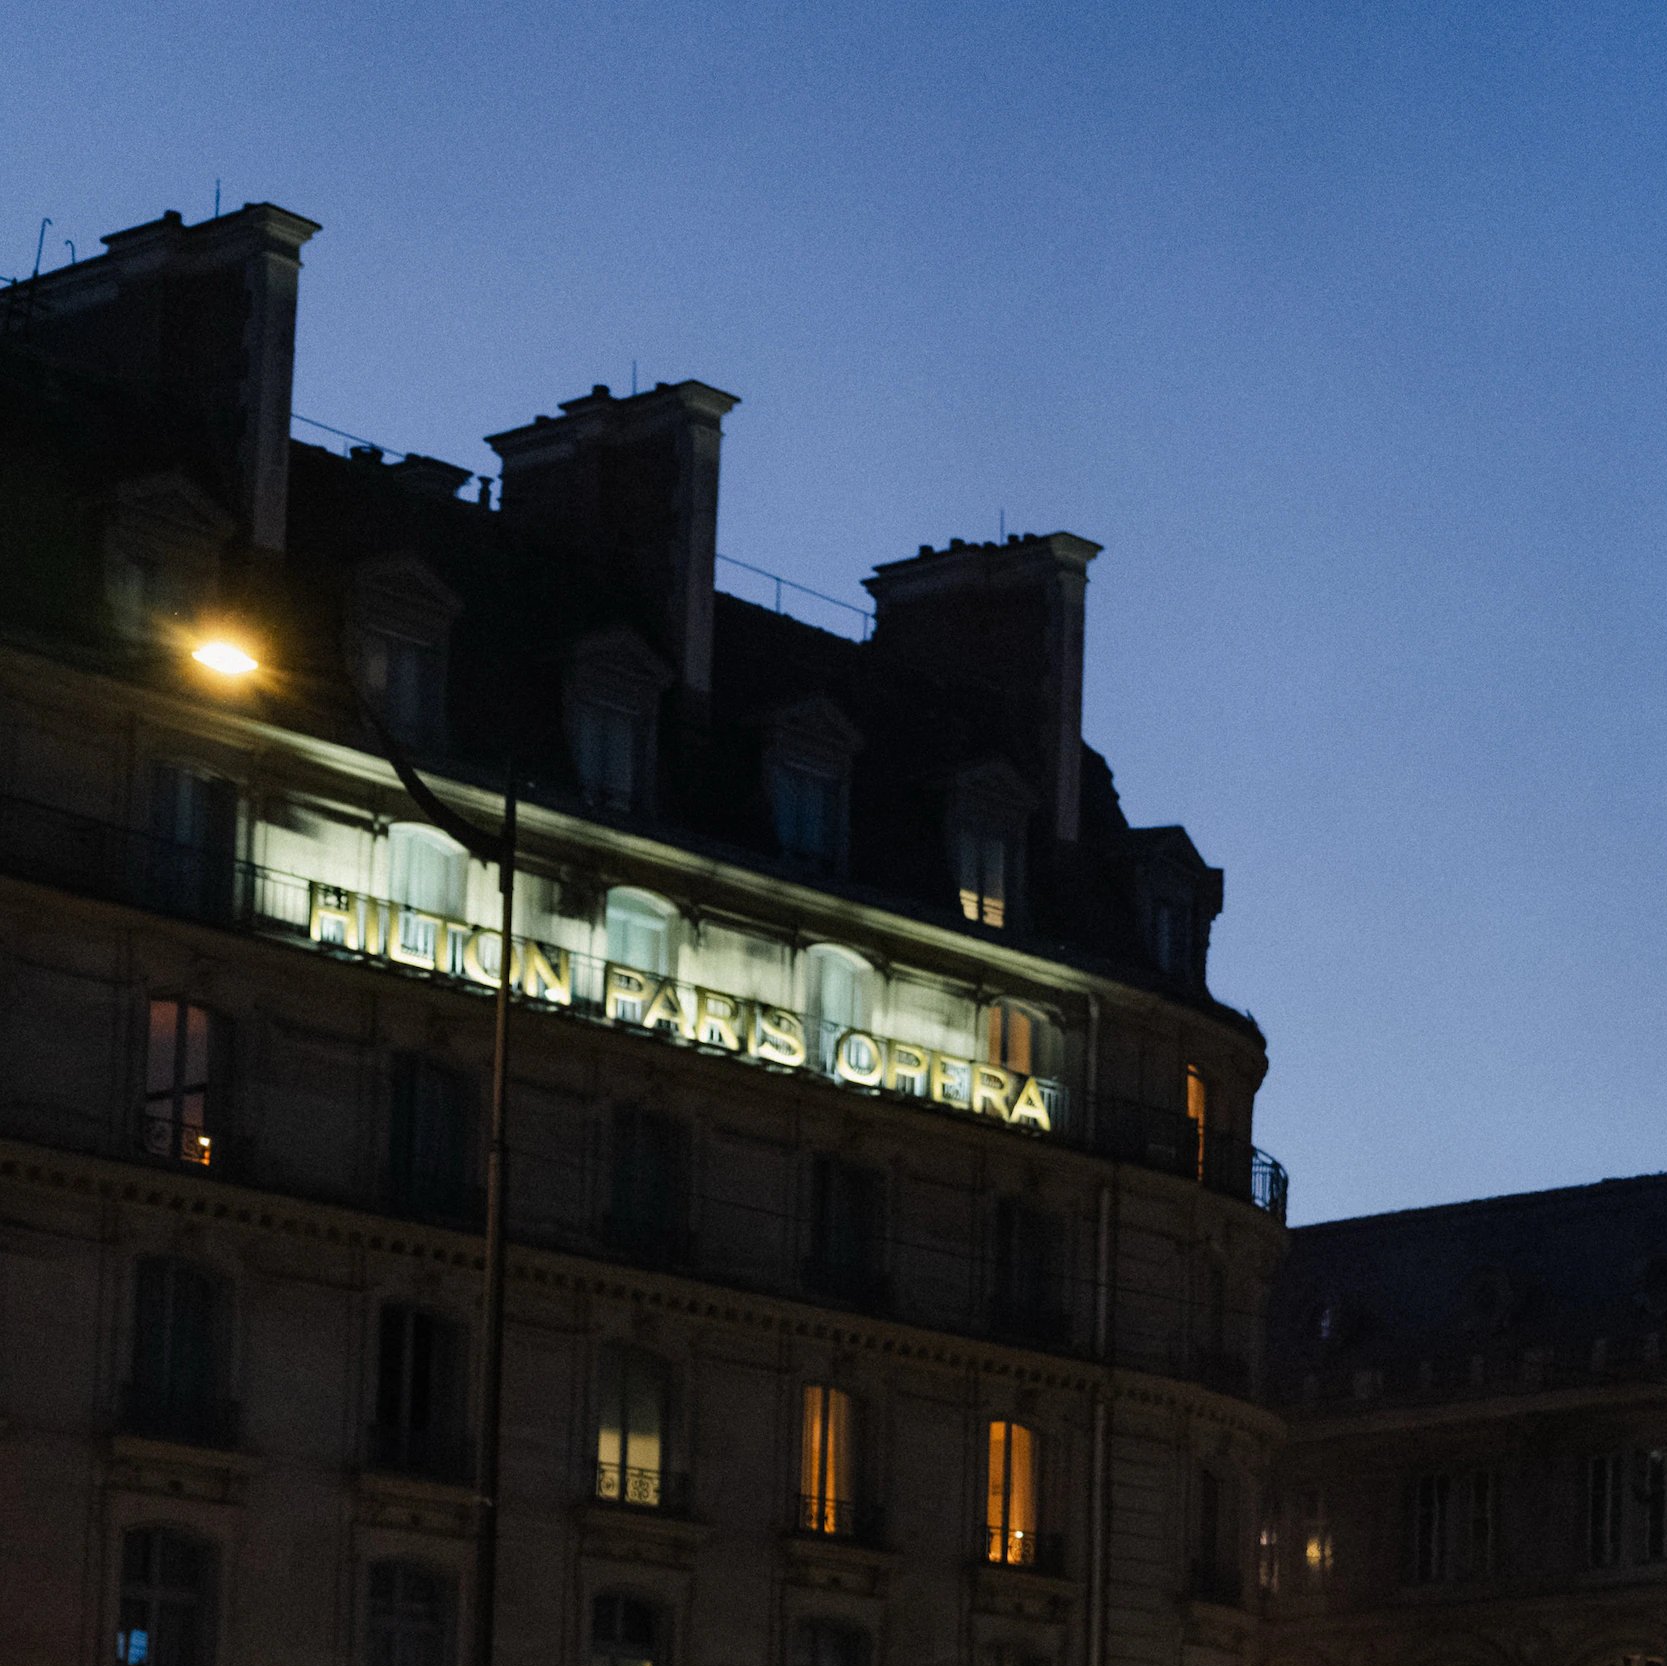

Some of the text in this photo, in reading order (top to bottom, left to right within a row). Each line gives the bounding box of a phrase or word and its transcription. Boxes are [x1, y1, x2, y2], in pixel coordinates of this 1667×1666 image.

[309, 881, 1052, 1132] HILTON PARIS OPERA
